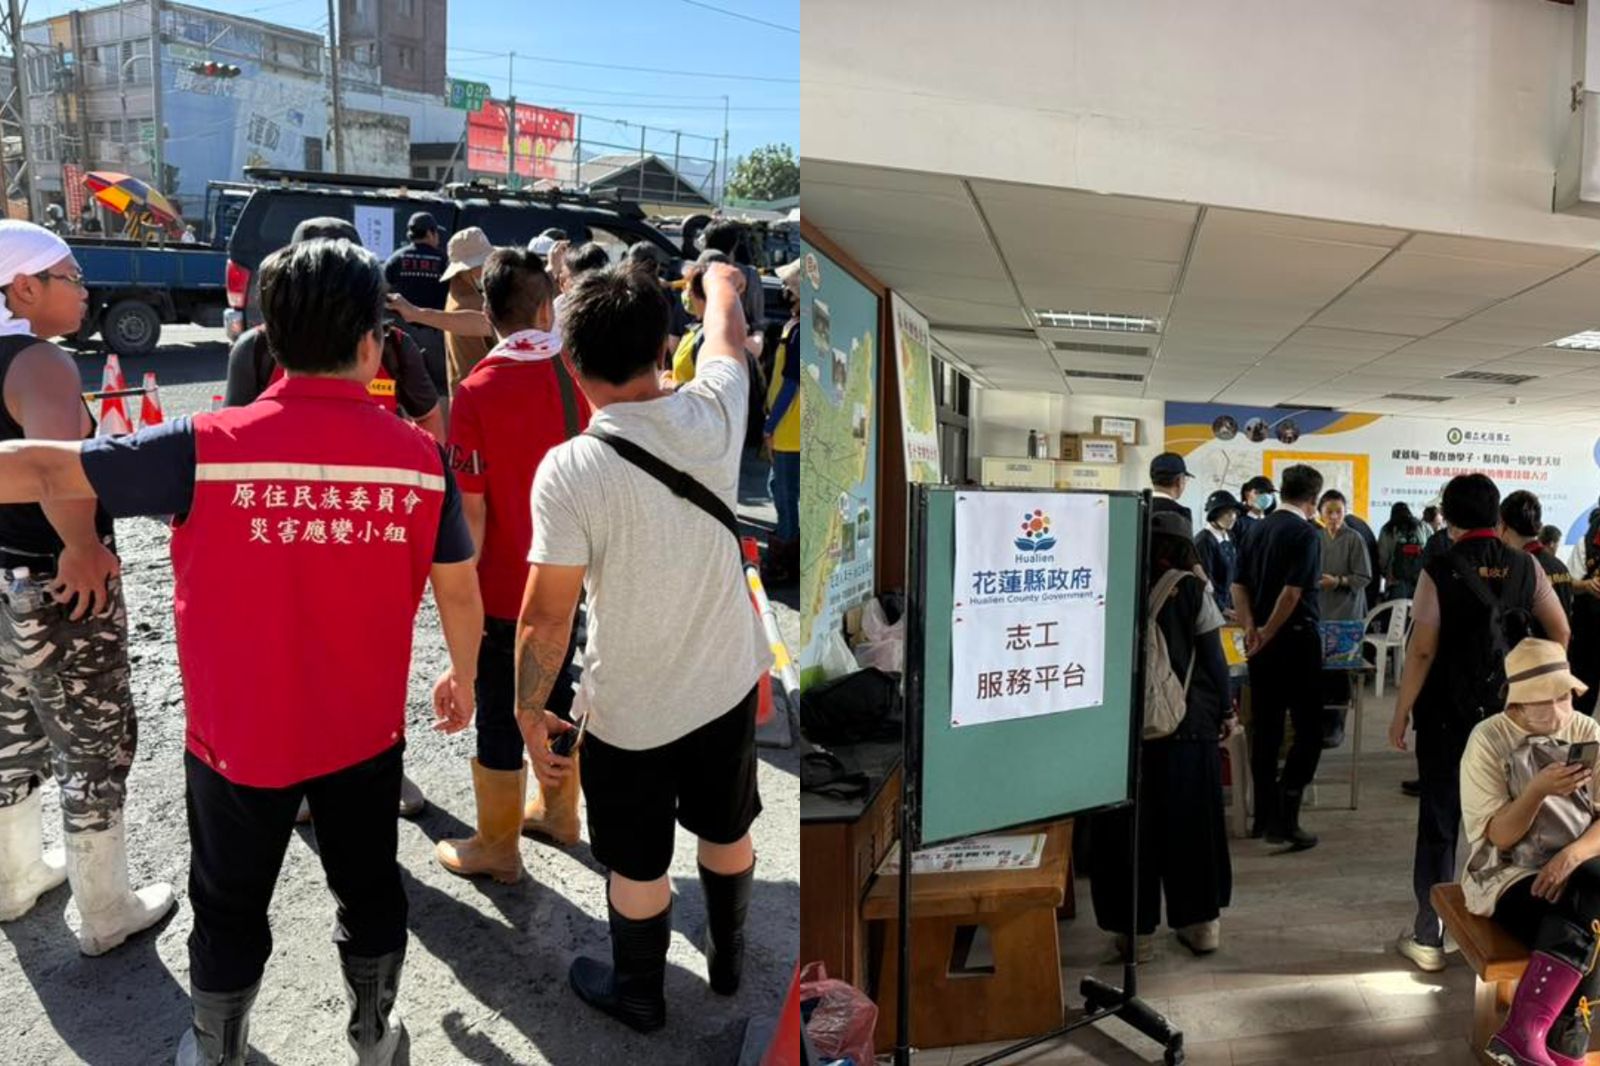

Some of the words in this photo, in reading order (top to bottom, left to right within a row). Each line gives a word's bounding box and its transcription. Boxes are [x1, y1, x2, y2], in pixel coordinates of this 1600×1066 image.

[401, 259, 439, 270] FIRE
[231, 483, 423, 514] 原住民族委員會
[248, 517, 408, 545] 災害應變小組
[1015, 553, 1054, 564] Hualien
[972, 566, 1092, 595] 花蓮縣政府
[969, 594, 1005, 605] Hualien
[1007, 594, 1039, 604] County
[1042, 591, 1093, 602] Government
[1005, 621, 1059, 651] 志工
[976, 662, 1086, 700] 服務平台
